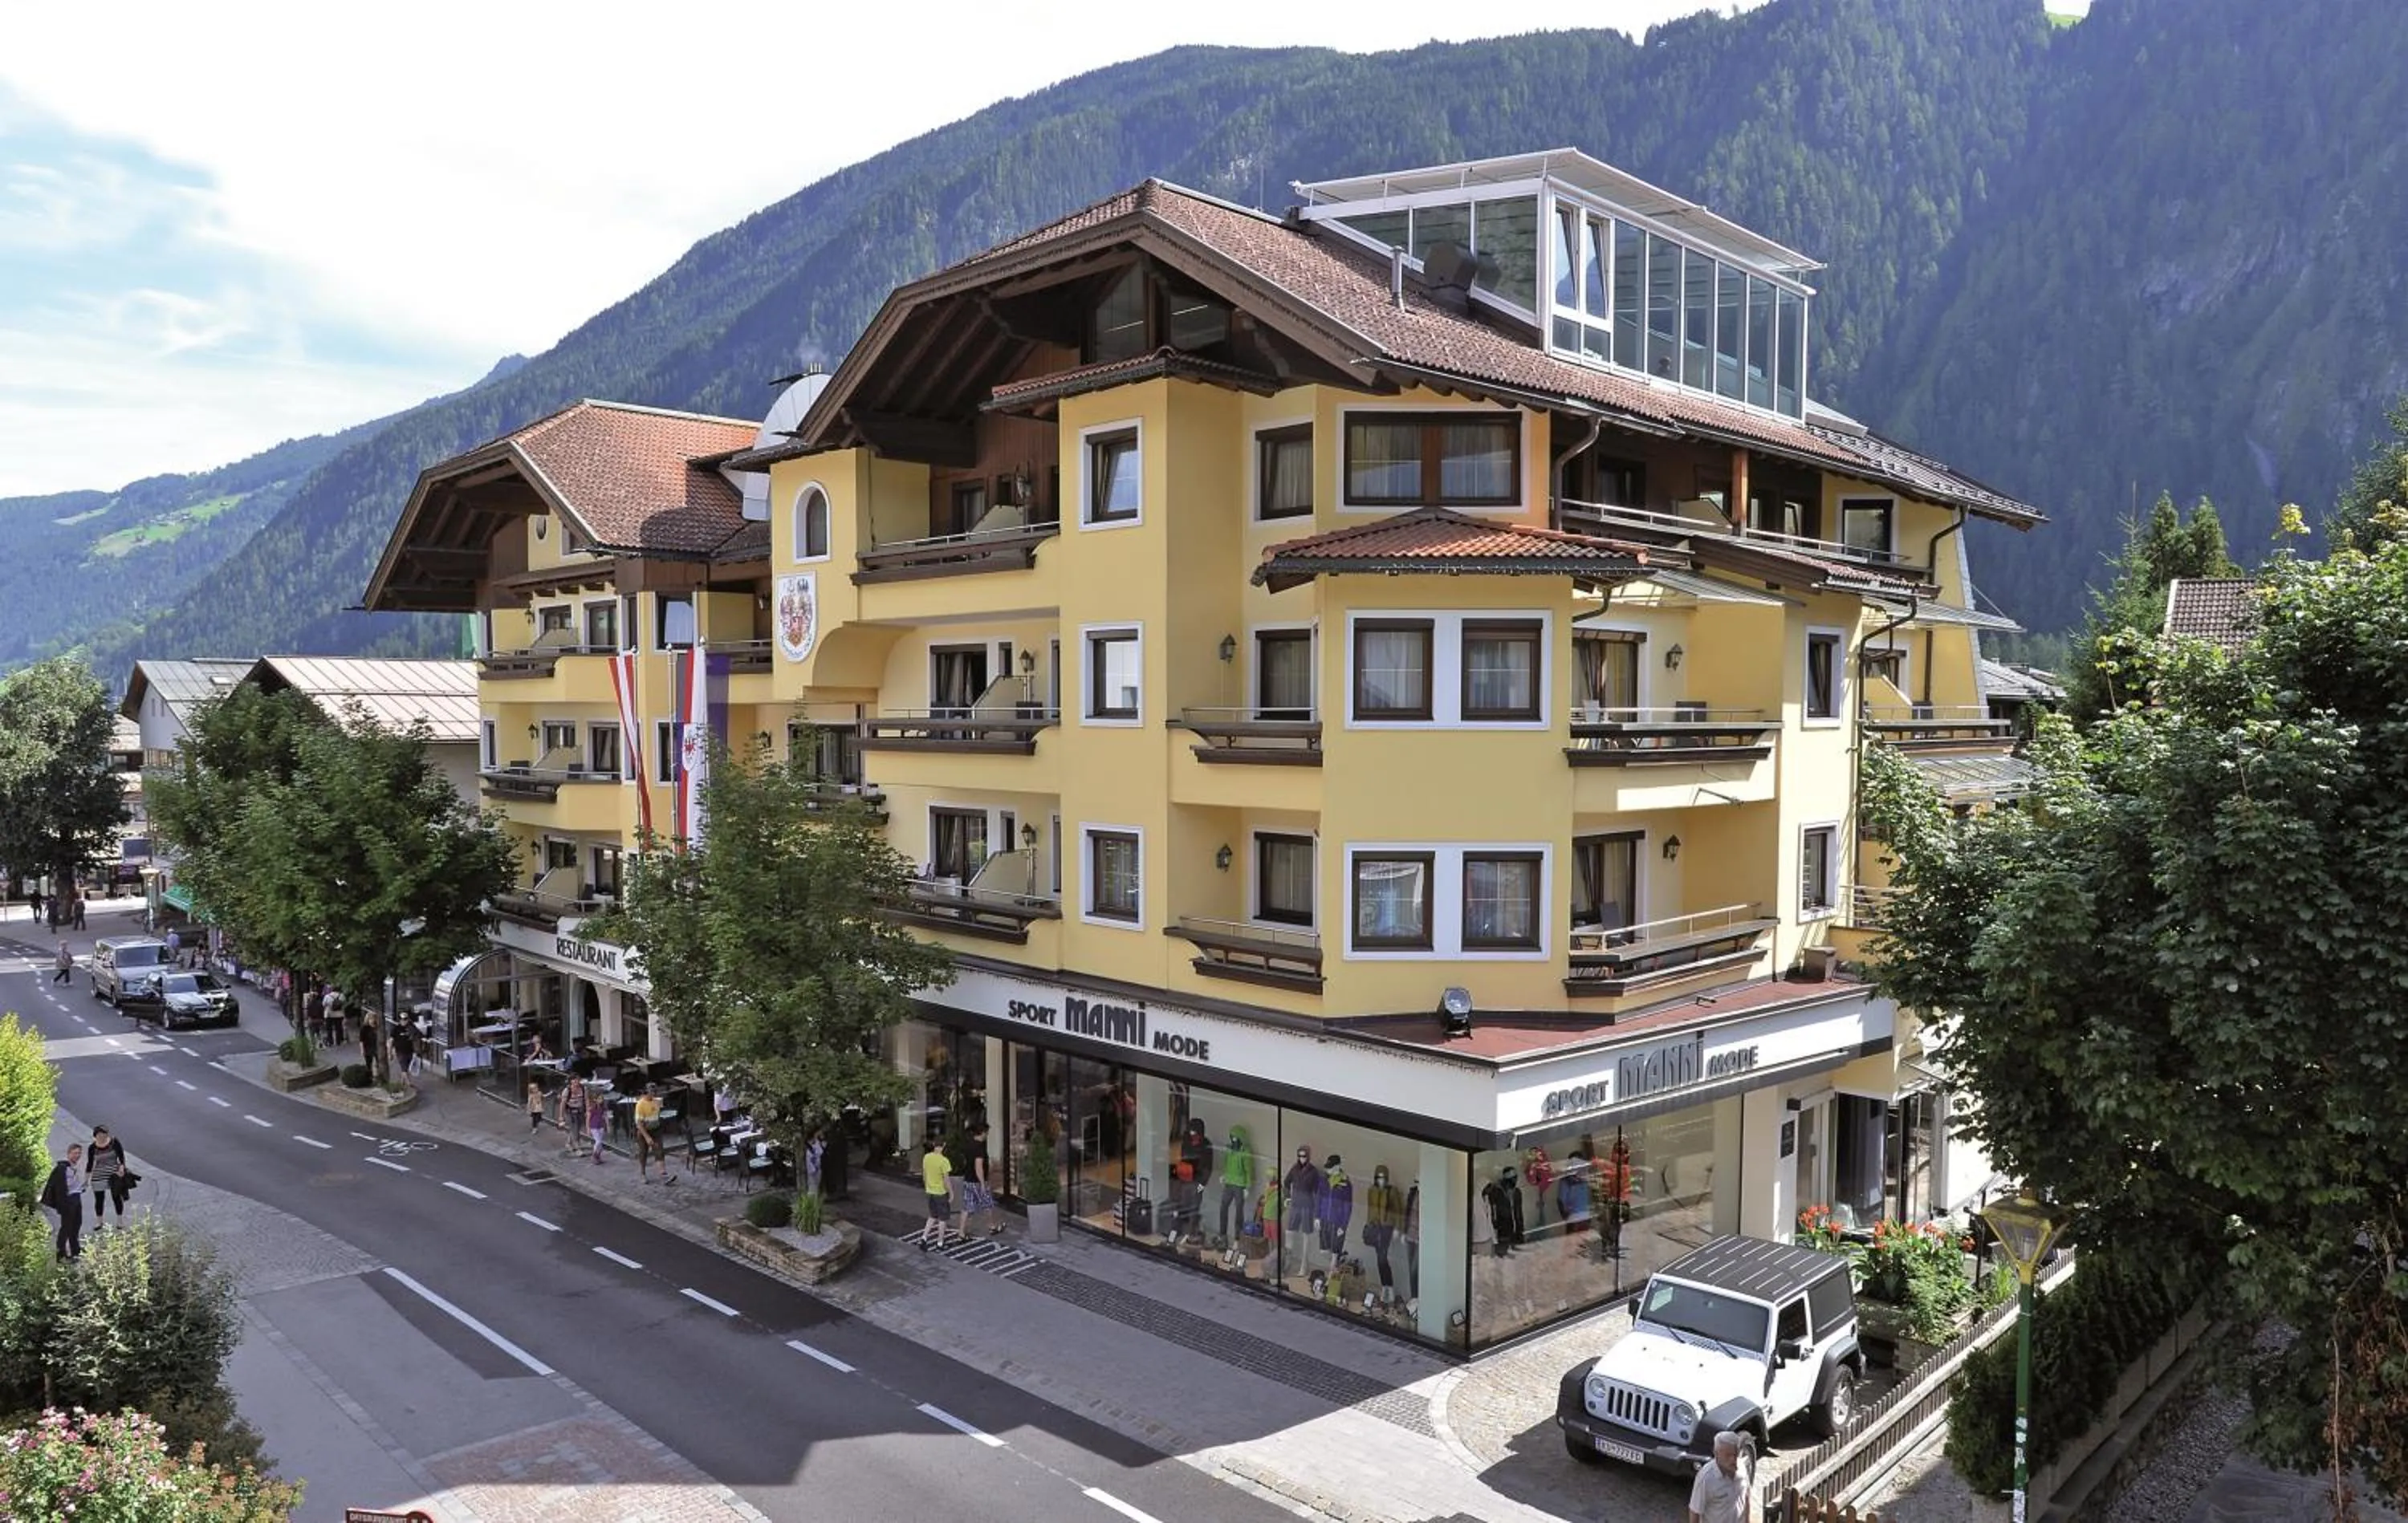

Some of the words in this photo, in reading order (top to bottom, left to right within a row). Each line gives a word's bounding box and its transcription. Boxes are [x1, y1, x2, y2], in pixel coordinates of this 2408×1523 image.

[556, 937, 616, 971] RESTAURANT
[1008, 1000, 1057, 1025] SPORT
[1153, 1032, 1210, 1060] MODE
[1544, 1079, 1609, 1115] SPORT
[1708, 1046, 1759, 1077] MODE
